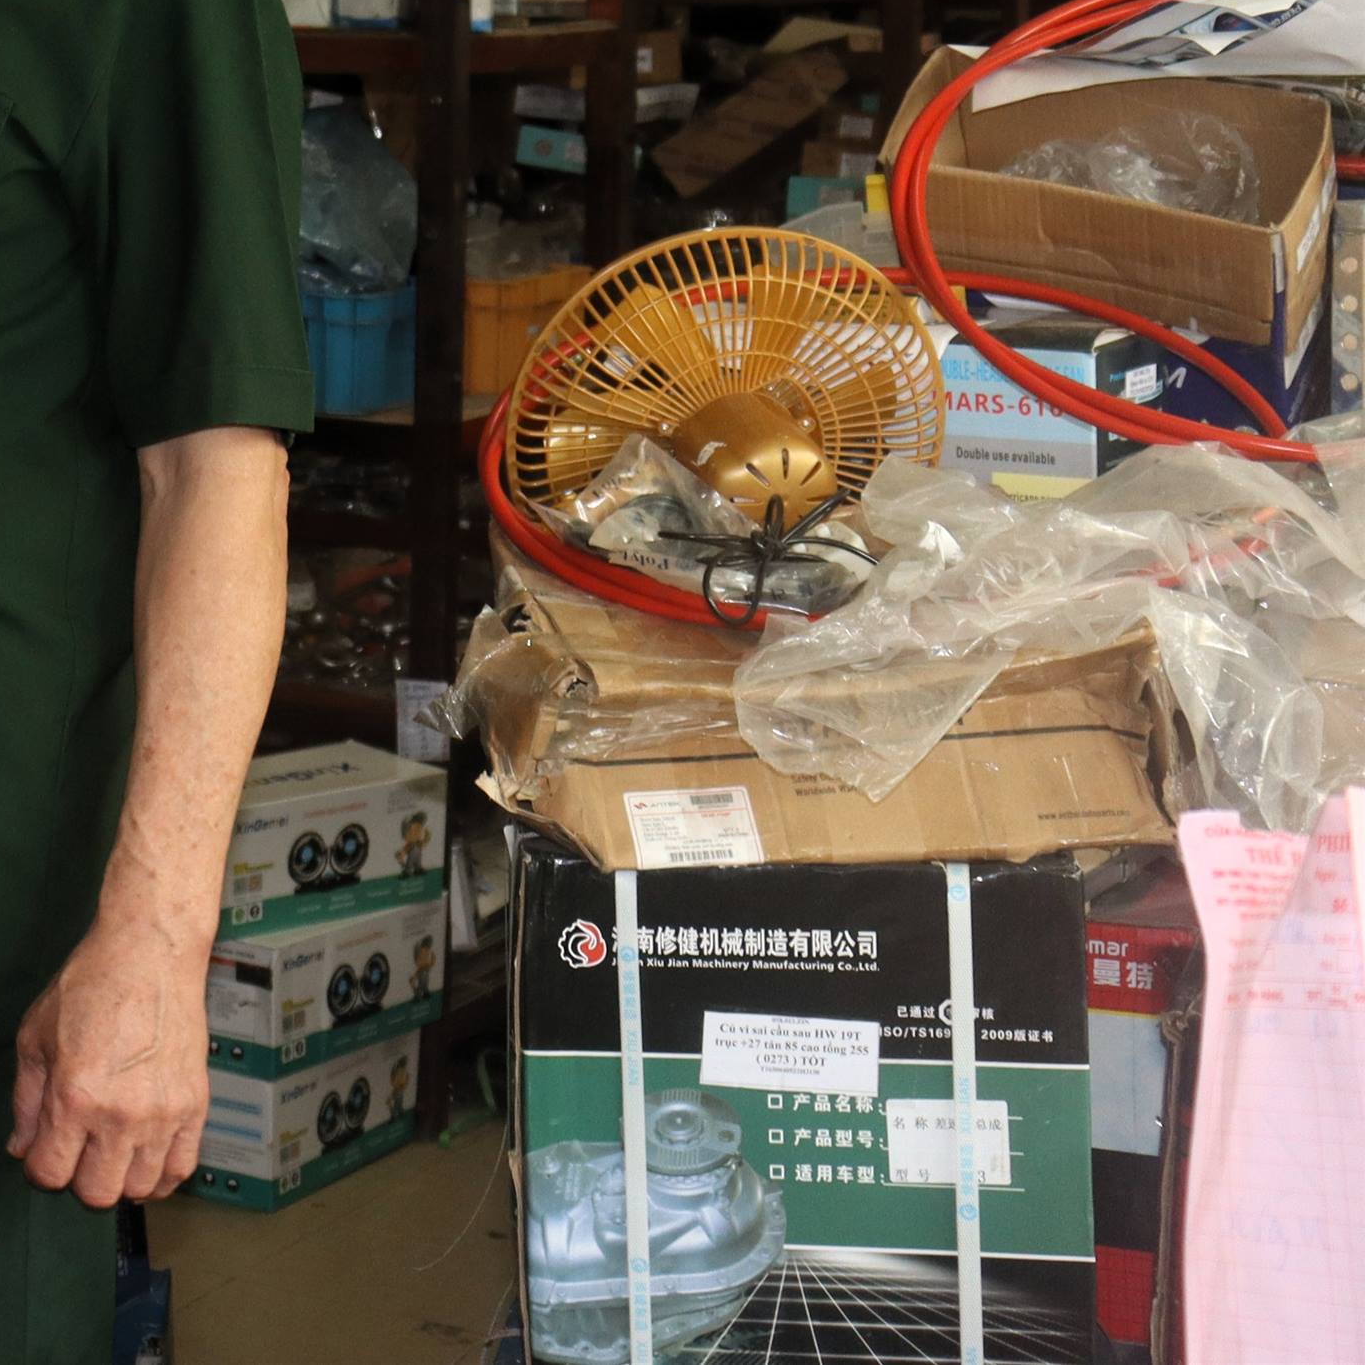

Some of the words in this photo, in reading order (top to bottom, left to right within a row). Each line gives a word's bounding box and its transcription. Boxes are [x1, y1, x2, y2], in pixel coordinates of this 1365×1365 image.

[956, 446, 990, 462] Double
[992, 450, 1010, 462] use
[1012, 450, 1056, 467] available
[611, 924, 879, 960] 南修健机械制造有限公司
[646, 958, 666, 969] Xiu
[667, 958, 690, 969] Jian
[691, 957, 750, 972] Machinery
[752, 959, 836, 973] Manufacturing
[896, 1005, 935, 1020] 已通过
[752, 1024, 768, 1036] sai
[792, 1027, 813, 1039] sau
[815, 1027, 838, 1041] HW
[840, 1029, 862, 1042] 19T
[878, 1024, 953, 1040] ISO/TS169
[784, 1041, 799, 1052] 85
[800, 1043, 820, 1054] cao
[849, 1044, 870, 1056] 255
